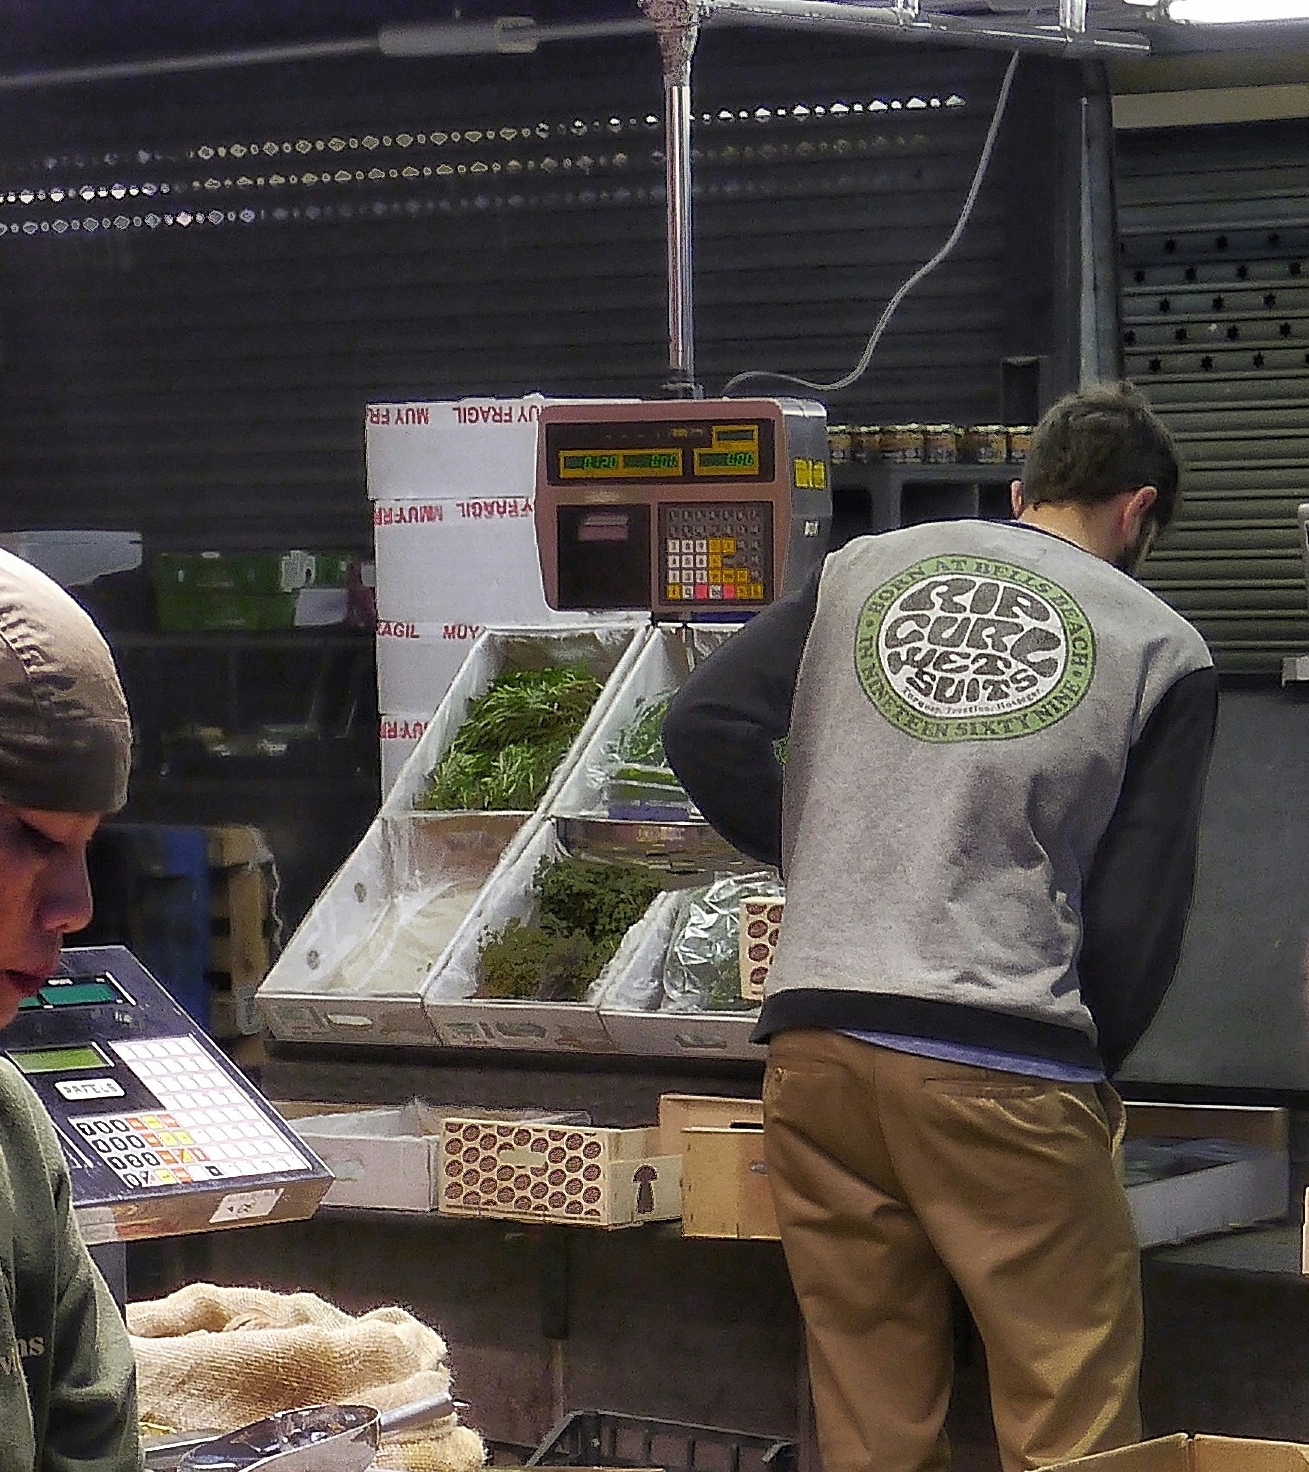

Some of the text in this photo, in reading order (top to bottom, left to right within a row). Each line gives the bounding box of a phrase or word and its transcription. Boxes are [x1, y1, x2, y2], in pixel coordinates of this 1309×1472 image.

[368, 408, 390, 425] FR
[395, 408, 429, 425] MUY
[453, 406, 513, 424] FRAGIL
[456, 500, 519, 518] FRAGIL
[899, 578, 1050, 622] RIP
[868, 559, 1090, 666] BORN AT BELLS BEACH
[442, 625, 480, 640] MUY
[884, 613, 1061, 678] CURL
[954, 718, 1030, 736] SIXTY
[1035, 684, 1081, 722] NINE
